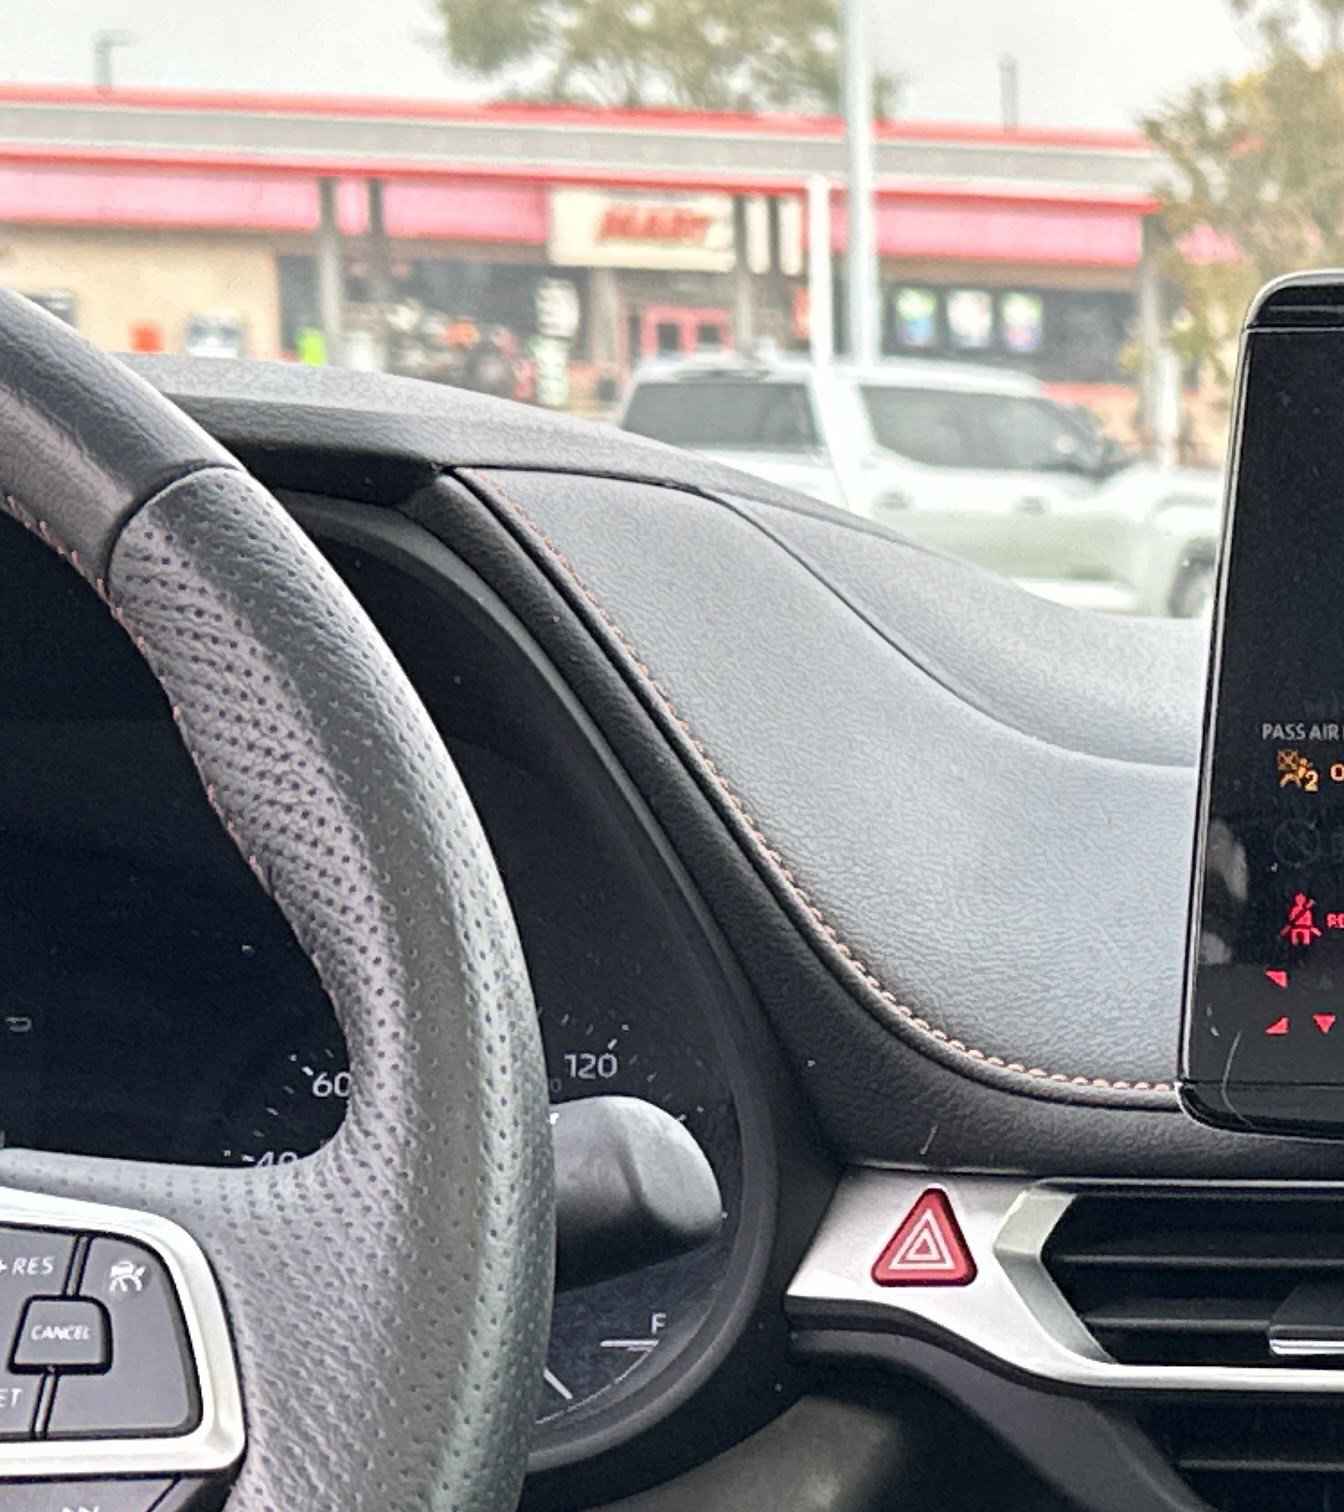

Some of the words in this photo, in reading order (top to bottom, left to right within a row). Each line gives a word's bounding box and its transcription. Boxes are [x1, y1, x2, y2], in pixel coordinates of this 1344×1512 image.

[1262, 723, 1306, 741] PASS
[1309, 723, 1340, 741] AIR
[564, 1053, 618, 1080] 120
[31, 1325, 92, 1341] CANCEL
[652, 1313, 667, 1334] F
